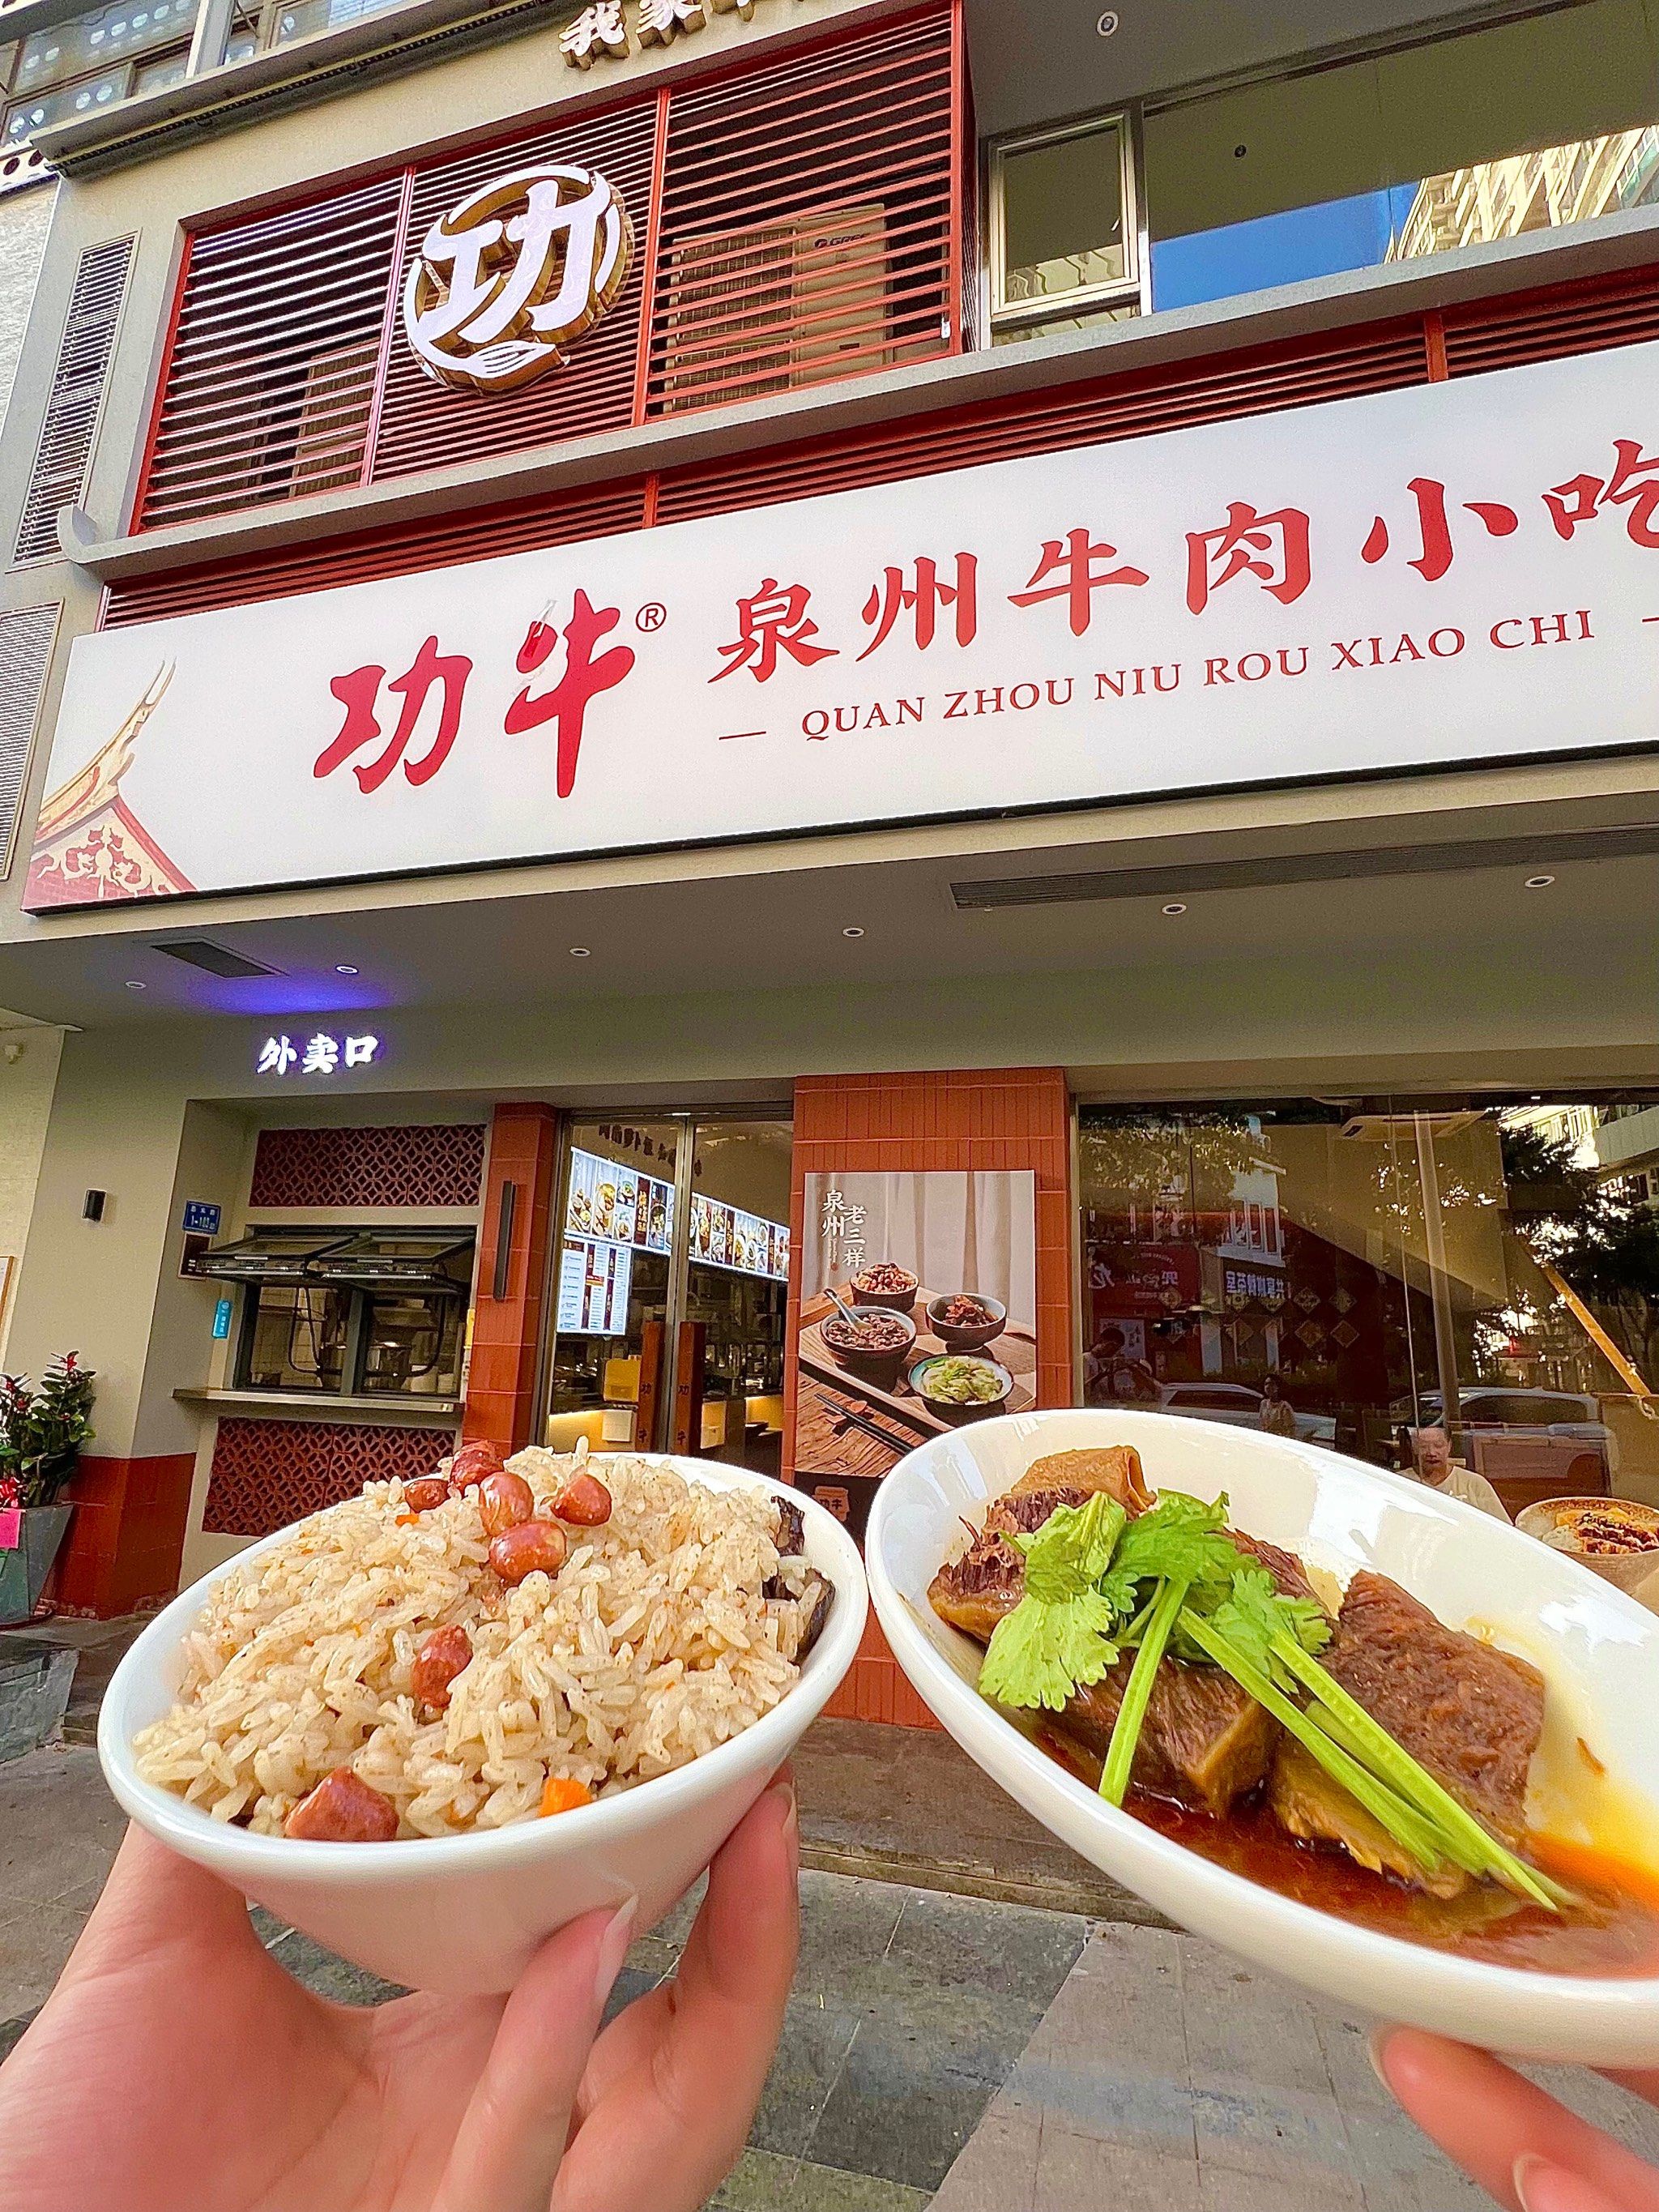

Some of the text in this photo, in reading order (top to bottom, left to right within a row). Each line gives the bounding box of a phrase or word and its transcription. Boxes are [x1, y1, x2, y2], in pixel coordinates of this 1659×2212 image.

[708, 438, 1659, 684] 泉州牛肉小吃
[313, 589, 636, 798] 功牛
[801, 609, 1596, 741] QUAN ZHOU NIU ROU XIAO CHI
[257, 1032, 379, 1076] 外卖口
[821, 1189, 848, 1237] 泉州
[842, 1204, 868, 1268] 老三样
